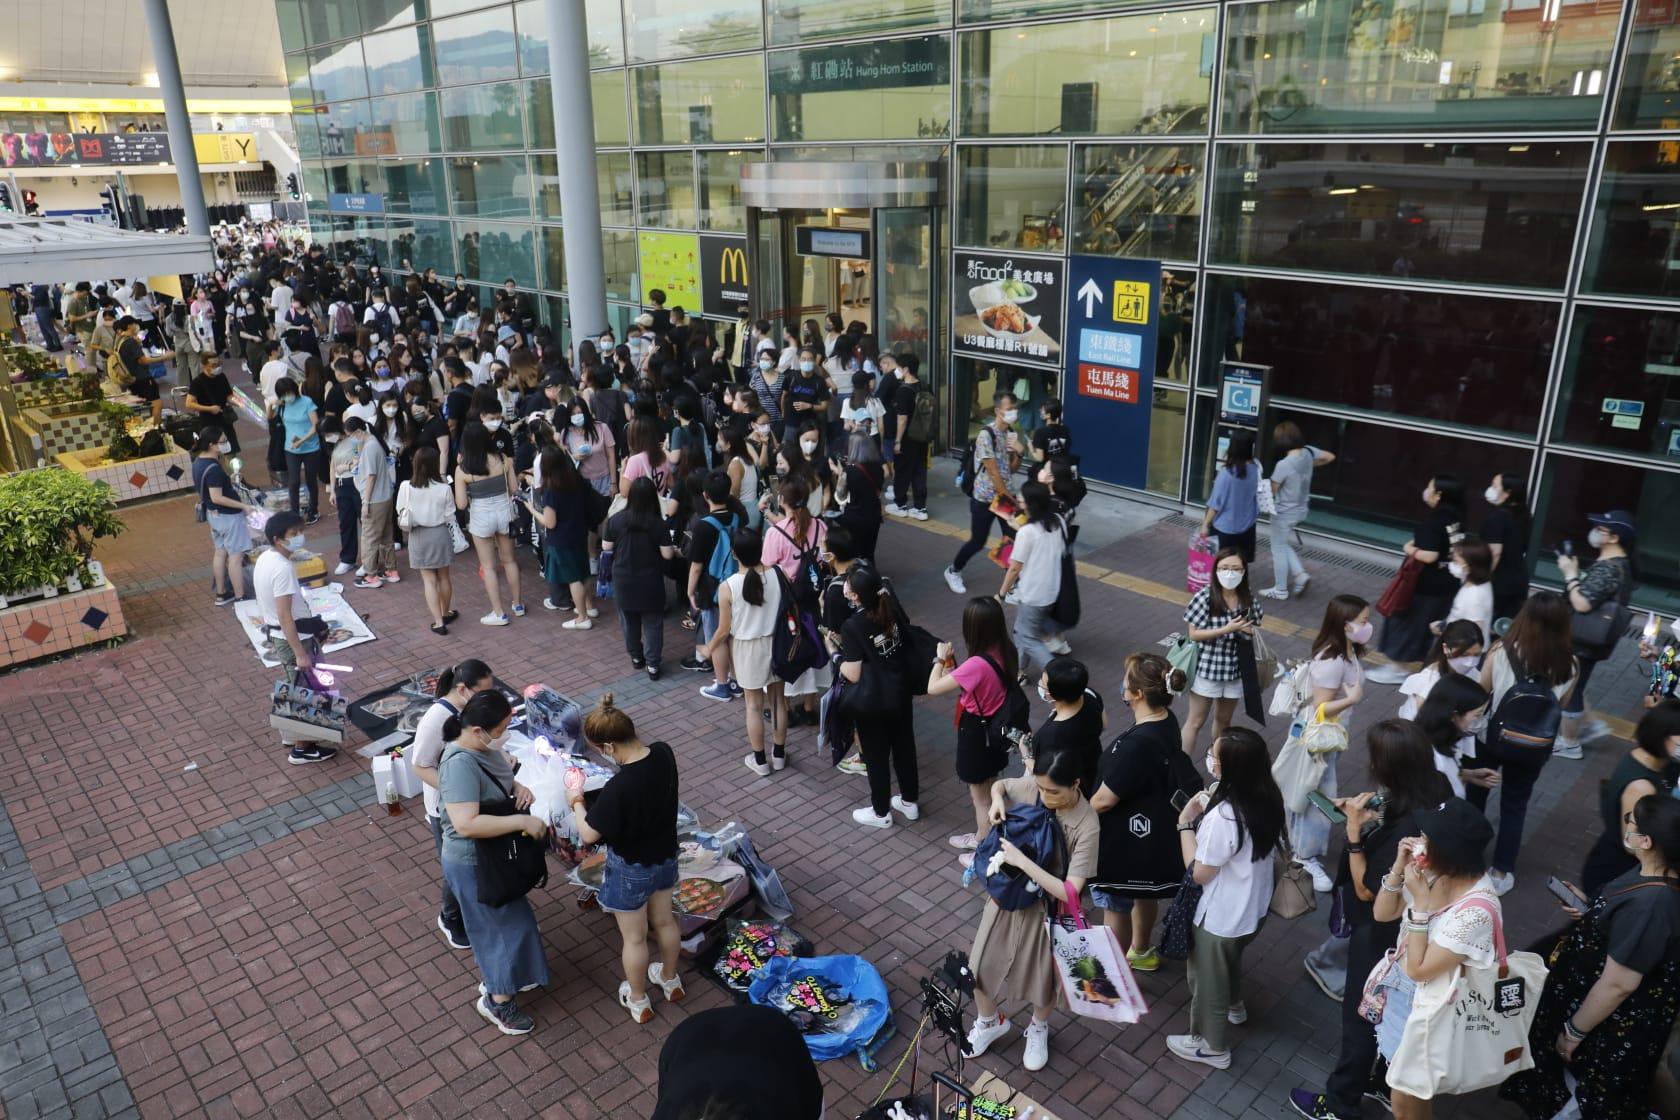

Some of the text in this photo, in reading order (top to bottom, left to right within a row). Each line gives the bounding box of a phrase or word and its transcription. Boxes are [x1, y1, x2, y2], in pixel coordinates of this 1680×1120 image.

[856, 61, 933, 79] Hung Hom Station
[235, 138, 251, 157] Y
[1088, 351, 1103, 360] East
[1086, 384, 1130, 399] Tuen Ma Line
